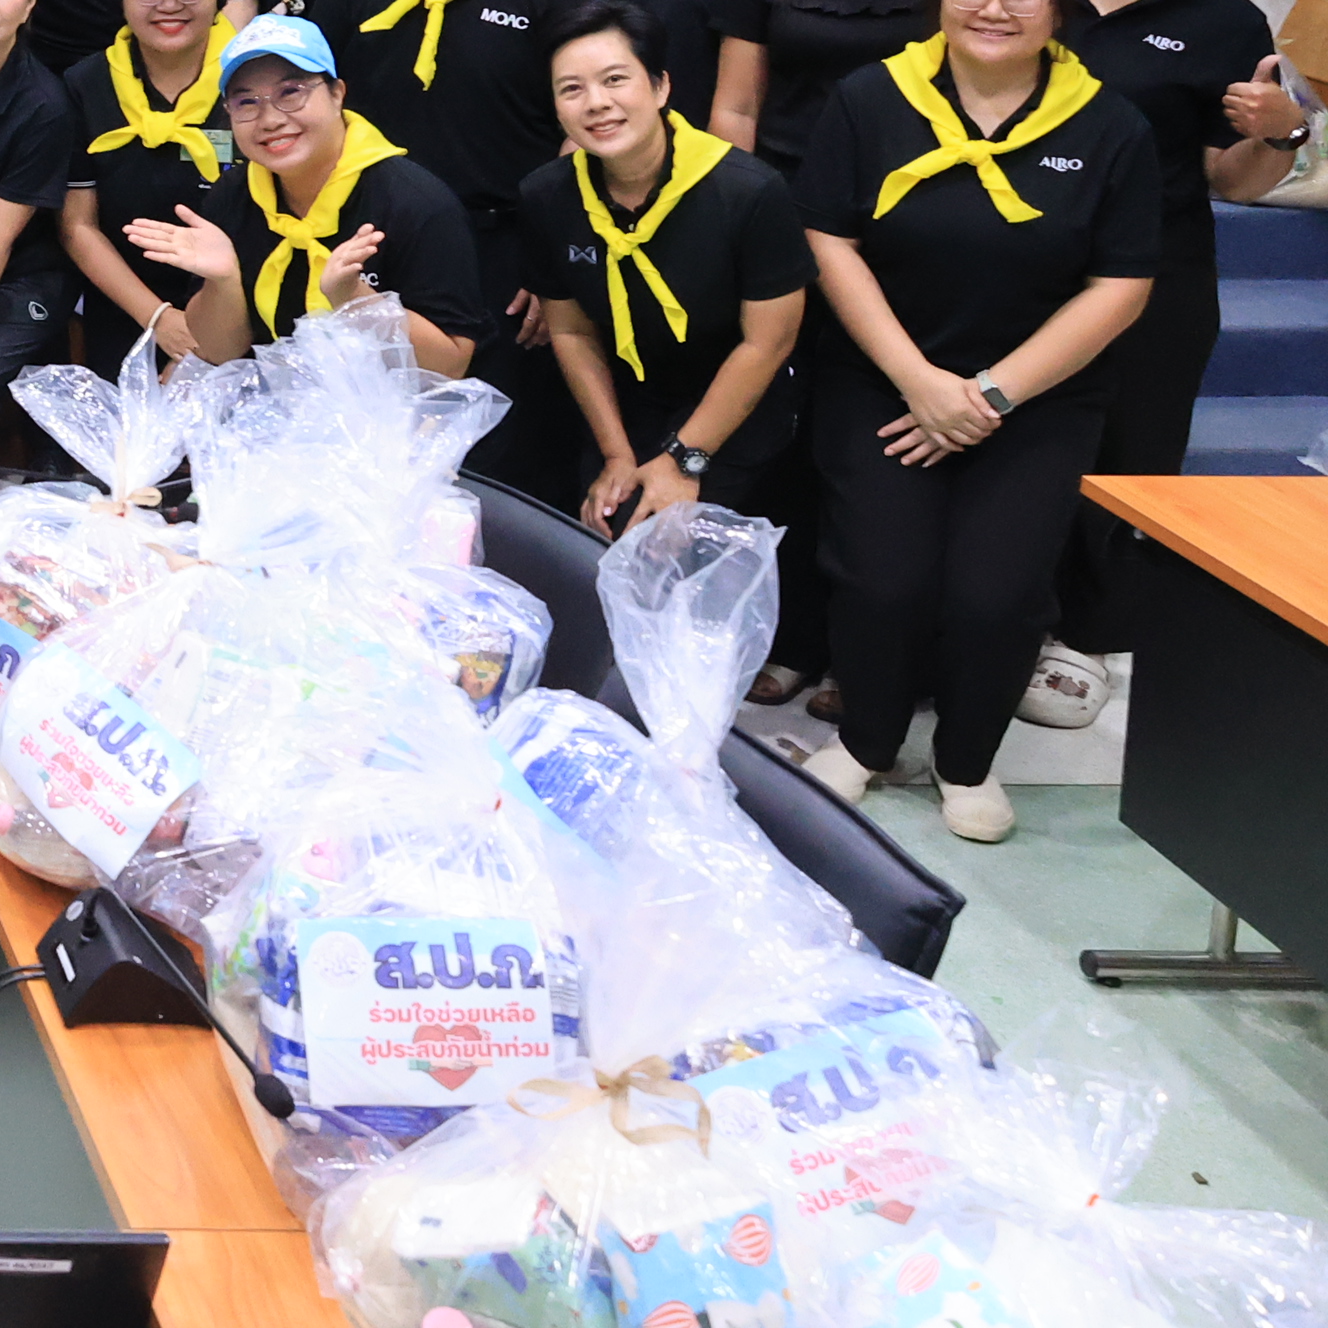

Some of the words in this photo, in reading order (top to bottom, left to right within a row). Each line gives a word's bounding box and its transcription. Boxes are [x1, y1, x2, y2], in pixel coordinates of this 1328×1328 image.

[480, 7, 530, 30] MOAC
[1142, 33, 1186, 53] ALRO
[1039, 156, 1084, 172] ALRO
[369, 1000, 536, 1023] ร่วมใจช่วยเหลือ
[361, 1029, 550, 1065] ผู้ประสบภัยน้ำท่วม
